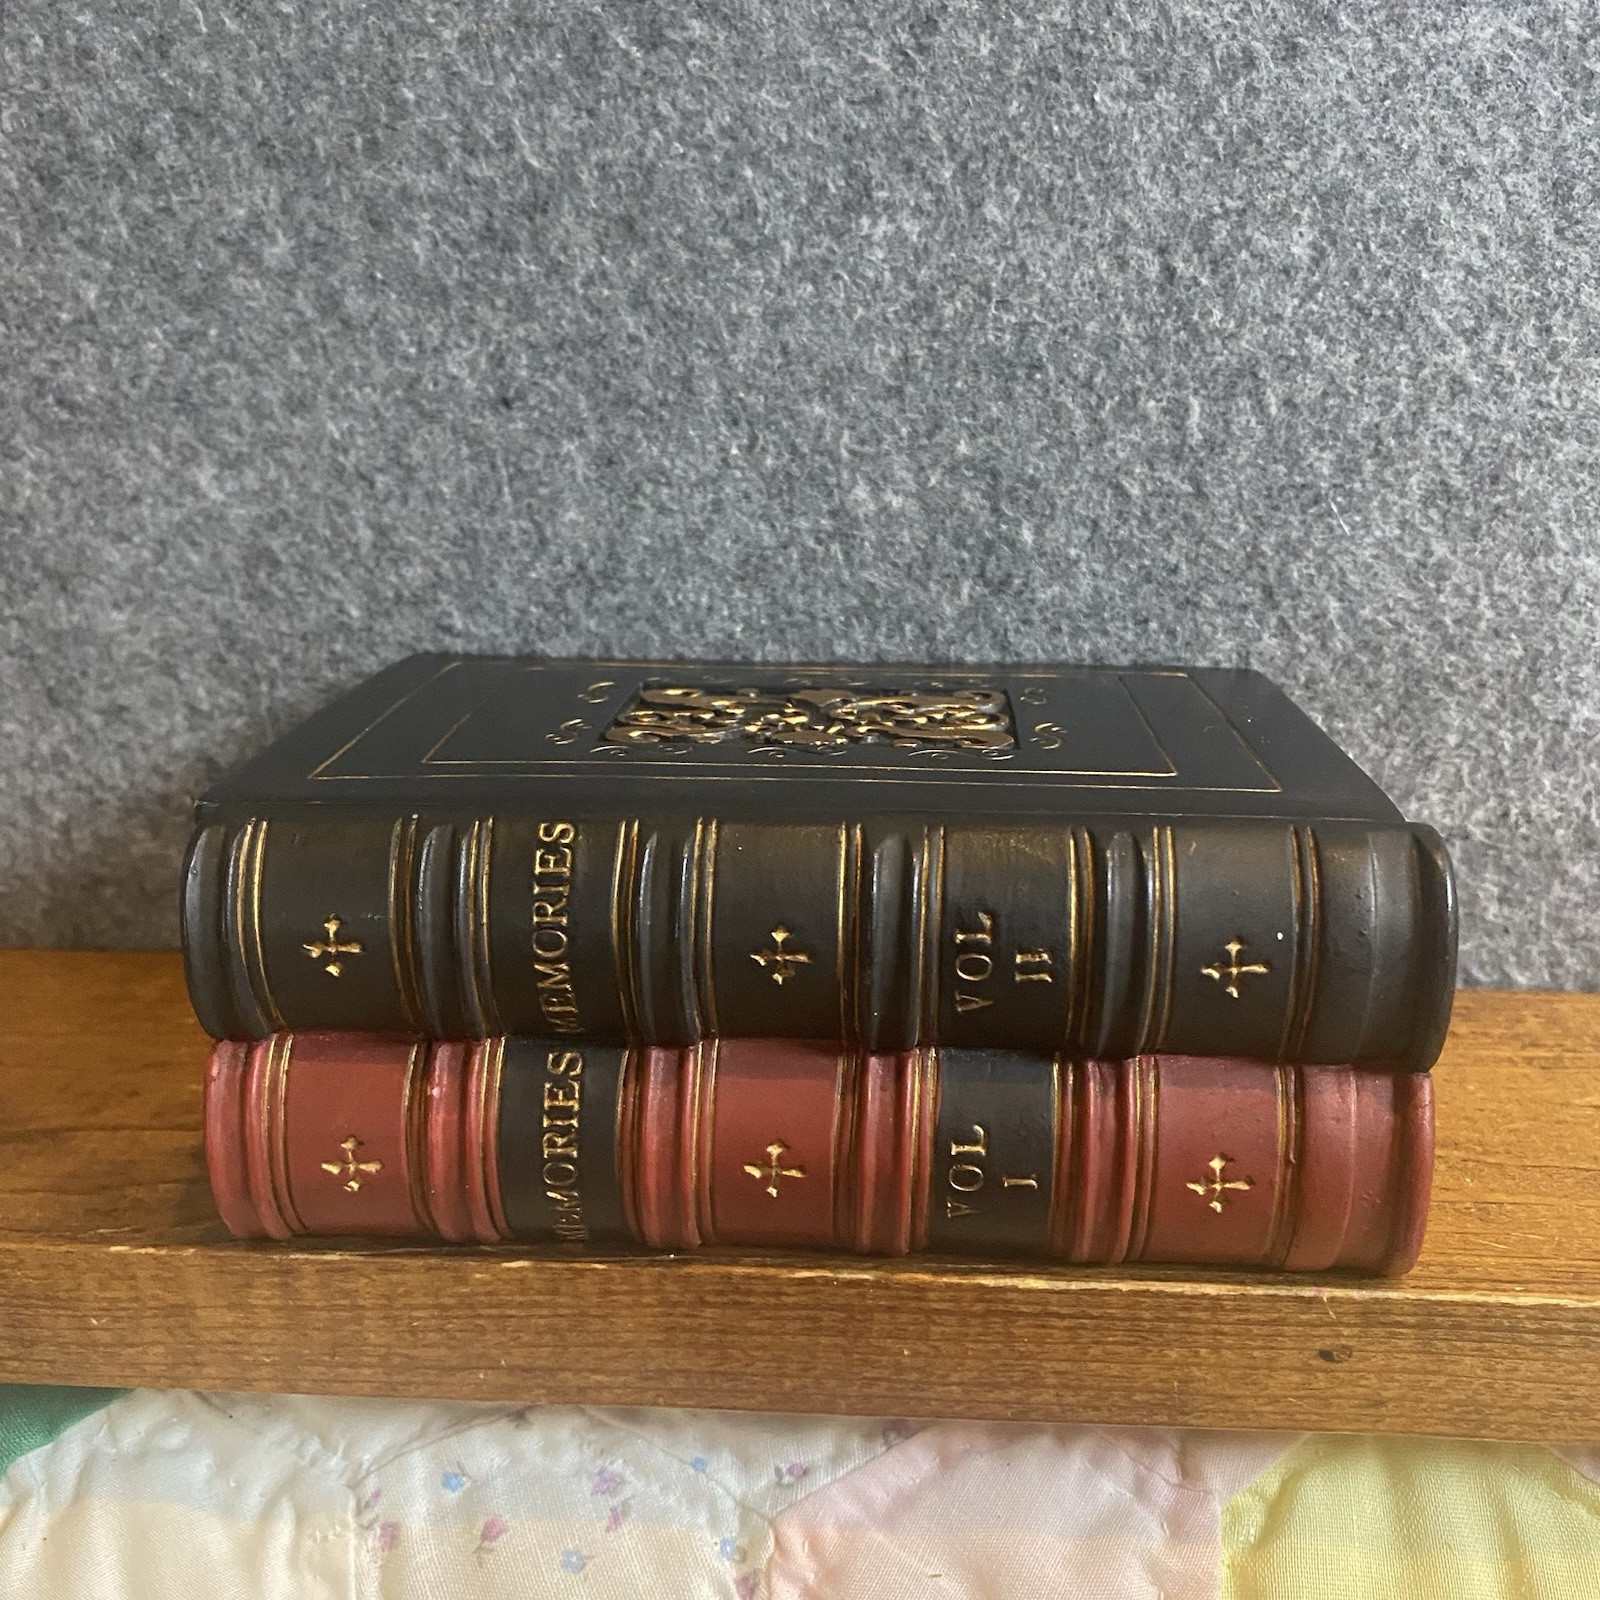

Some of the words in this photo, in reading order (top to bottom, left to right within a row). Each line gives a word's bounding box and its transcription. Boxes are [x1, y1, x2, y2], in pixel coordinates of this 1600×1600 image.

[532, 820, 585, 1035] MEMORIES
[954, 911, 994, 1013] VOL
[1014, 947, 1053, 983] II
[541, 1049, 588, 1243] MEMORIES
[946, 1123, 987, 1218] VOL
[1002, 1173, 1038, 1190] I
